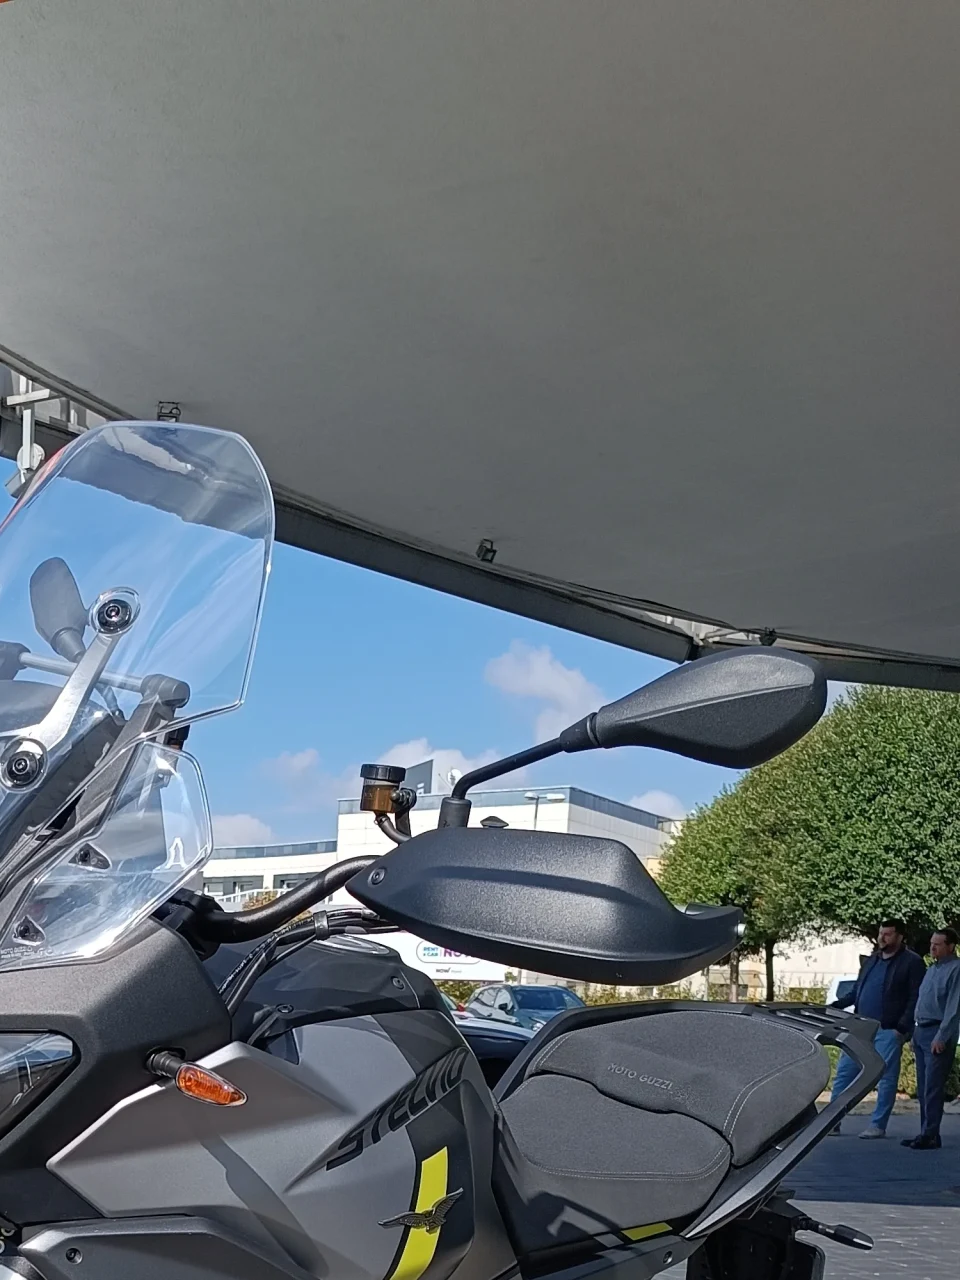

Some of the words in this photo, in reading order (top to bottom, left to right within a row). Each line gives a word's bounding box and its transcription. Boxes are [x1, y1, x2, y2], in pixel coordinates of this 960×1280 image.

[326, 1046, 469, 1171] STELVIO
[607, 1063, 637, 1079] MOTO
[639, 1074, 674, 1090] GUZZI
